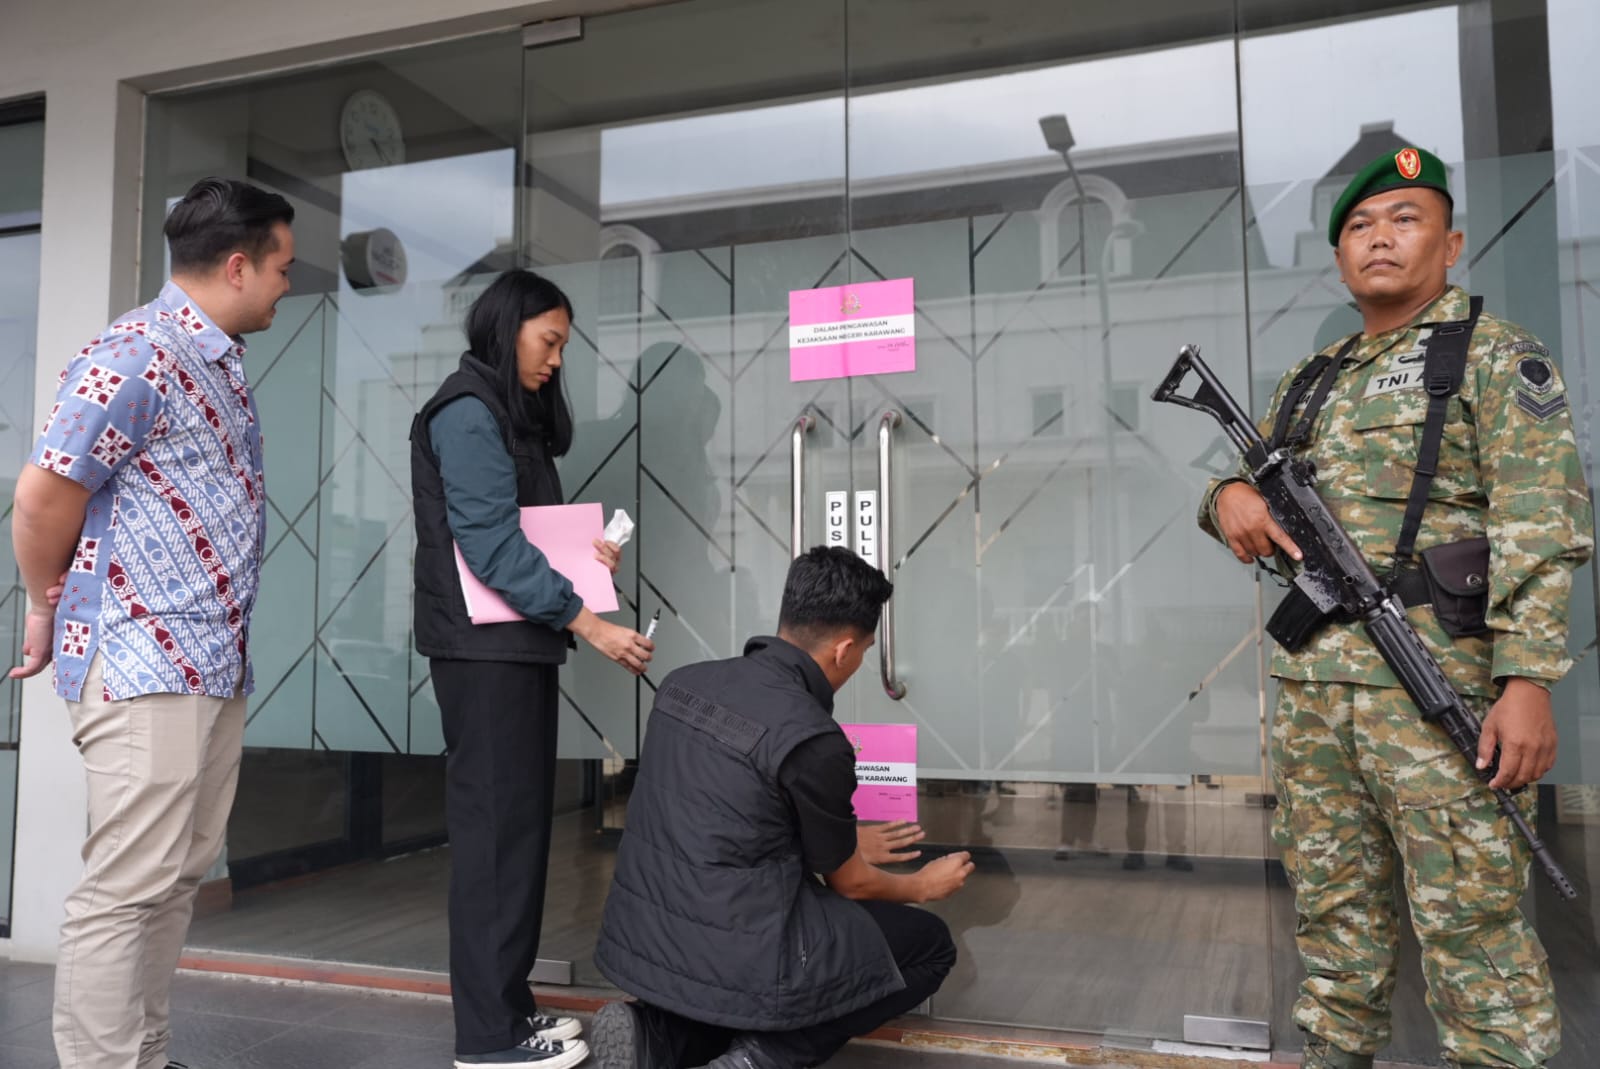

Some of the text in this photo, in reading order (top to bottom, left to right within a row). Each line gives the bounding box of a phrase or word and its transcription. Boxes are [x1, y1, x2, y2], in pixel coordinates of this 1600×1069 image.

[813, 320, 888, 334] DALAM PENGAWASAN
[797, 335, 837, 344] KEJAKSAAN
[864, 328, 906, 337] KARAWANG
[1377, 373, 1409, 389] TNI
[860, 500, 872, 556] PULL
